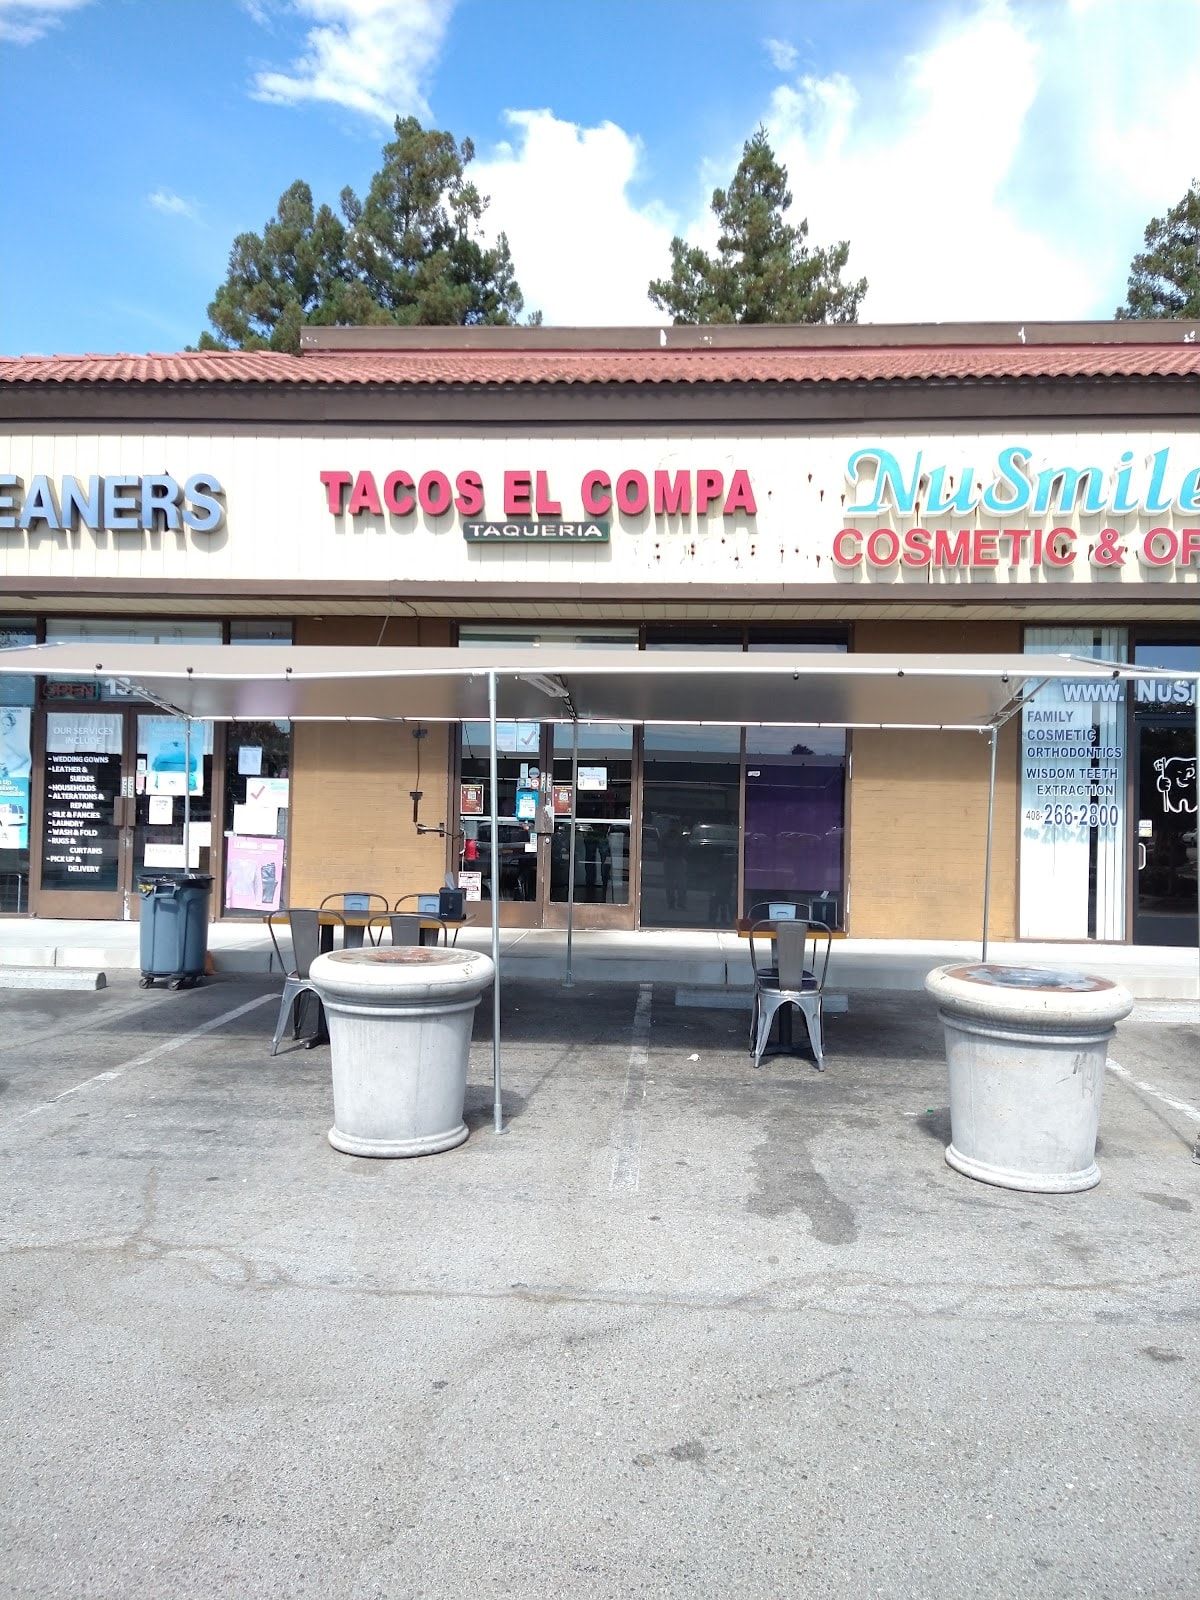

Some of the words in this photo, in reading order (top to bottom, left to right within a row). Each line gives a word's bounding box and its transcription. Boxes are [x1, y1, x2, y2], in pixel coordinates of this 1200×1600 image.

[320, 470, 485, 516] TACOS
[504, 470, 563, 516] EL
[581, 469, 758, 516] COMPA
[469, 525, 602, 538] TAQUERIA
[832, 527, 1078, 567] COSMETIC
[1094, 528, 1127, 566] &
[43, 682, 96, 698] OPEN
[1027, 711, 1074, 723] FAMILY
[53, 727, 72, 735] OUR
[74, 727, 114, 735] SERVICES
[1027, 729, 1097, 741] COSMETIC
[65, 736, 103, 745] INCLUDE
[1027, 747, 1123, 758] ORTHODONTICS
[69, 774, 95, 783] SUEDES
[1026, 768, 1075, 779] WISDOM
[1079, 768, 1118, 779] TEETH
[1037, 785, 1114, 796] EXTRACTION
[69, 801, 94, 810] REPAIR
[73, 811, 101, 819] FANCIES
[80, 829, 98, 837] FOLD
[69, 847, 103, 855] CURTAINS
[67, 865, 100, 873] DELIVERY
